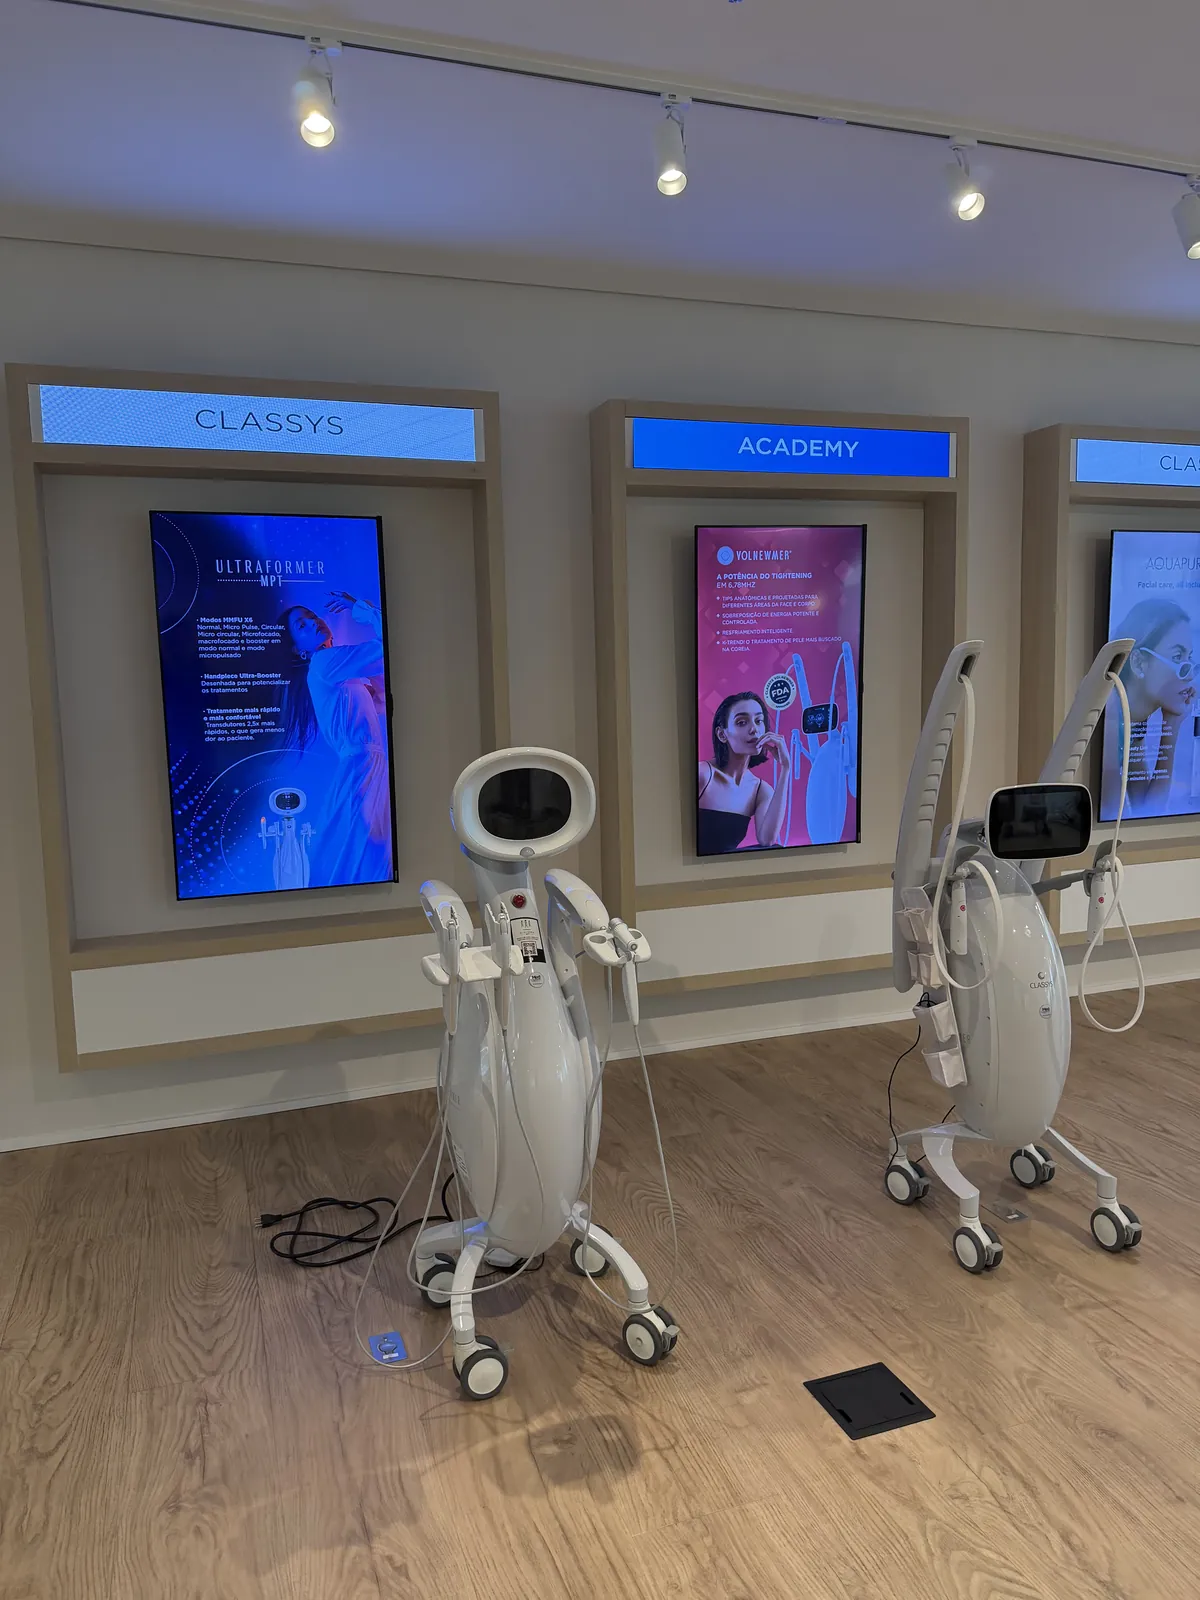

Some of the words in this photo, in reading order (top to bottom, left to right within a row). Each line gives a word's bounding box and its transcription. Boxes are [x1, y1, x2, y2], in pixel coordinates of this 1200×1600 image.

[196, 409, 344, 436] CLASSYS
[738, 436, 859, 458] ACADEMY
[216, 559, 324, 575] ULTRAFORMER
[260, 574, 283, 587] MPT
[724, 572, 758, 580] POTÊNCIA
[771, 686, 790, 698] FDA
